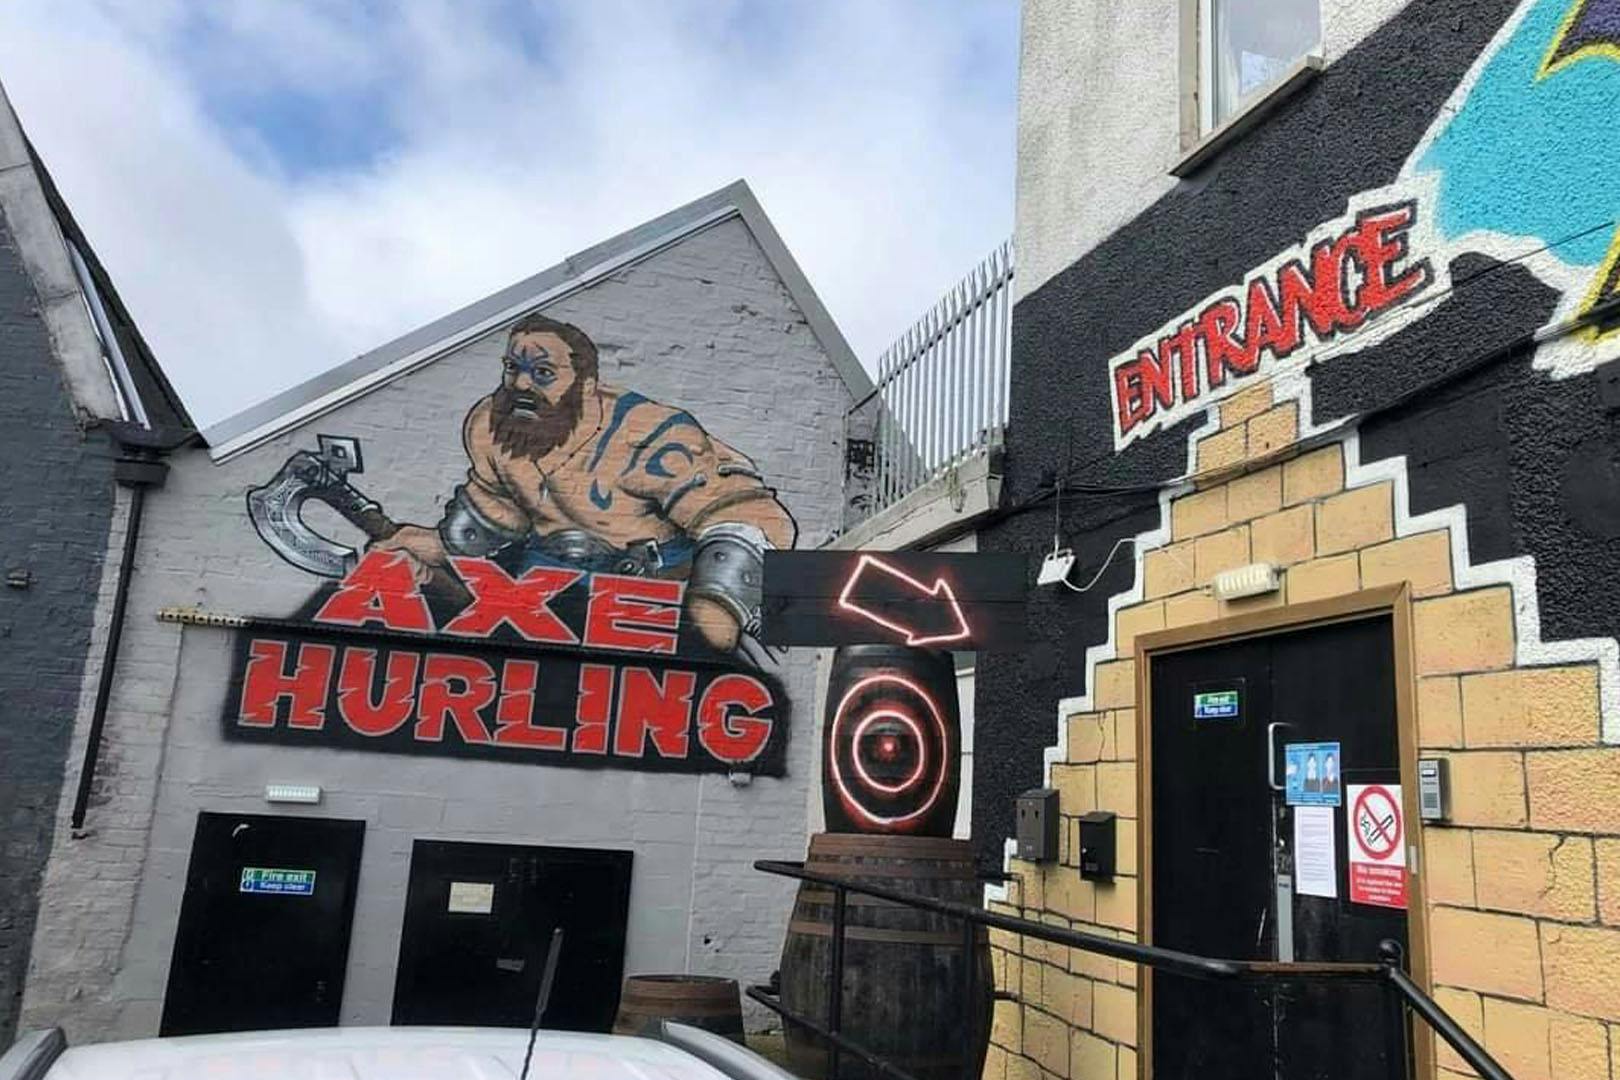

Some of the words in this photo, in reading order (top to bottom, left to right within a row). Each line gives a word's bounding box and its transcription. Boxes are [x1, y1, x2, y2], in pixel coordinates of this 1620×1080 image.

[1114, 200, 1435, 438] ENTRANCE
[313, 549, 688, 654] AXE
[237, 639, 773, 763] HURLING
[260, 882, 283, 891] Keep
[261, 872, 284, 882] Fire
[285, 873, 307, 883] exit
